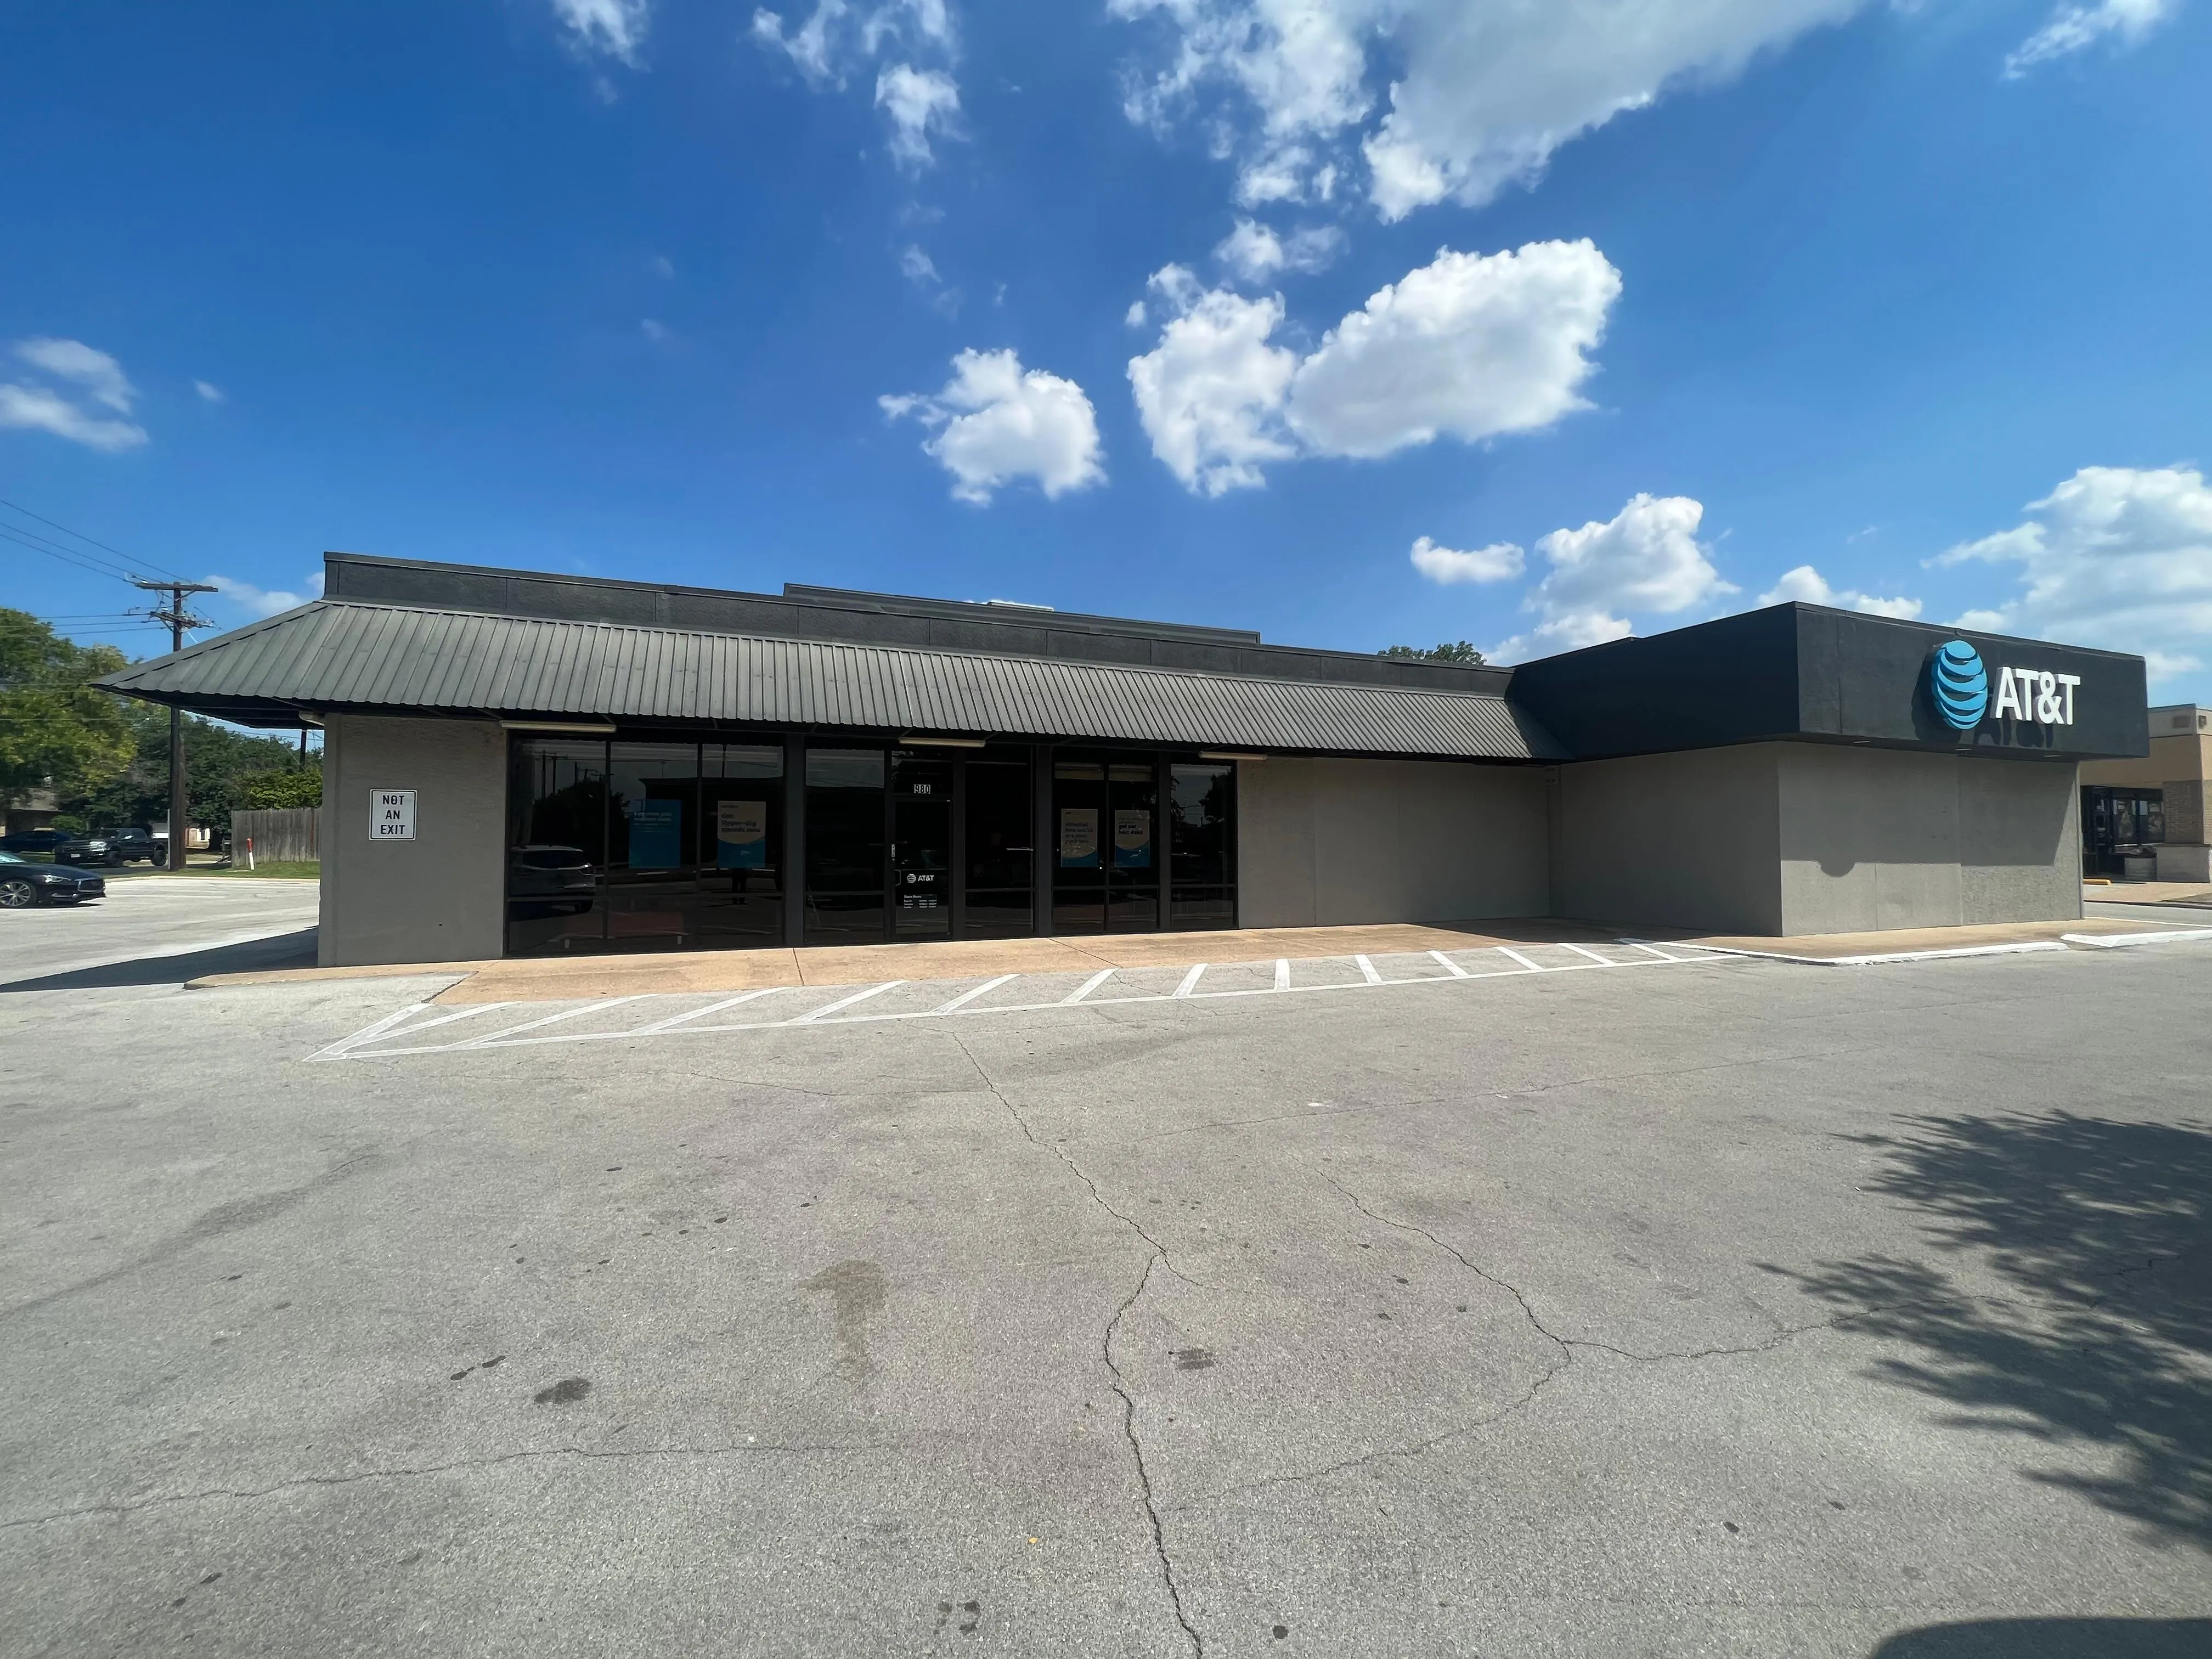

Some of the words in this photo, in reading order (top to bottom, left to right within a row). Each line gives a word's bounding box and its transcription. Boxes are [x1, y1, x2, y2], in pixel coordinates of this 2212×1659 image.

[1990, 667, 2081, 725] AT&T
[915, 785, 930, 794] 980
[382, 795, 405, 805] NOT
[385, 810, 400, 820] AN
[380, 825, 405, 834] EXIT
